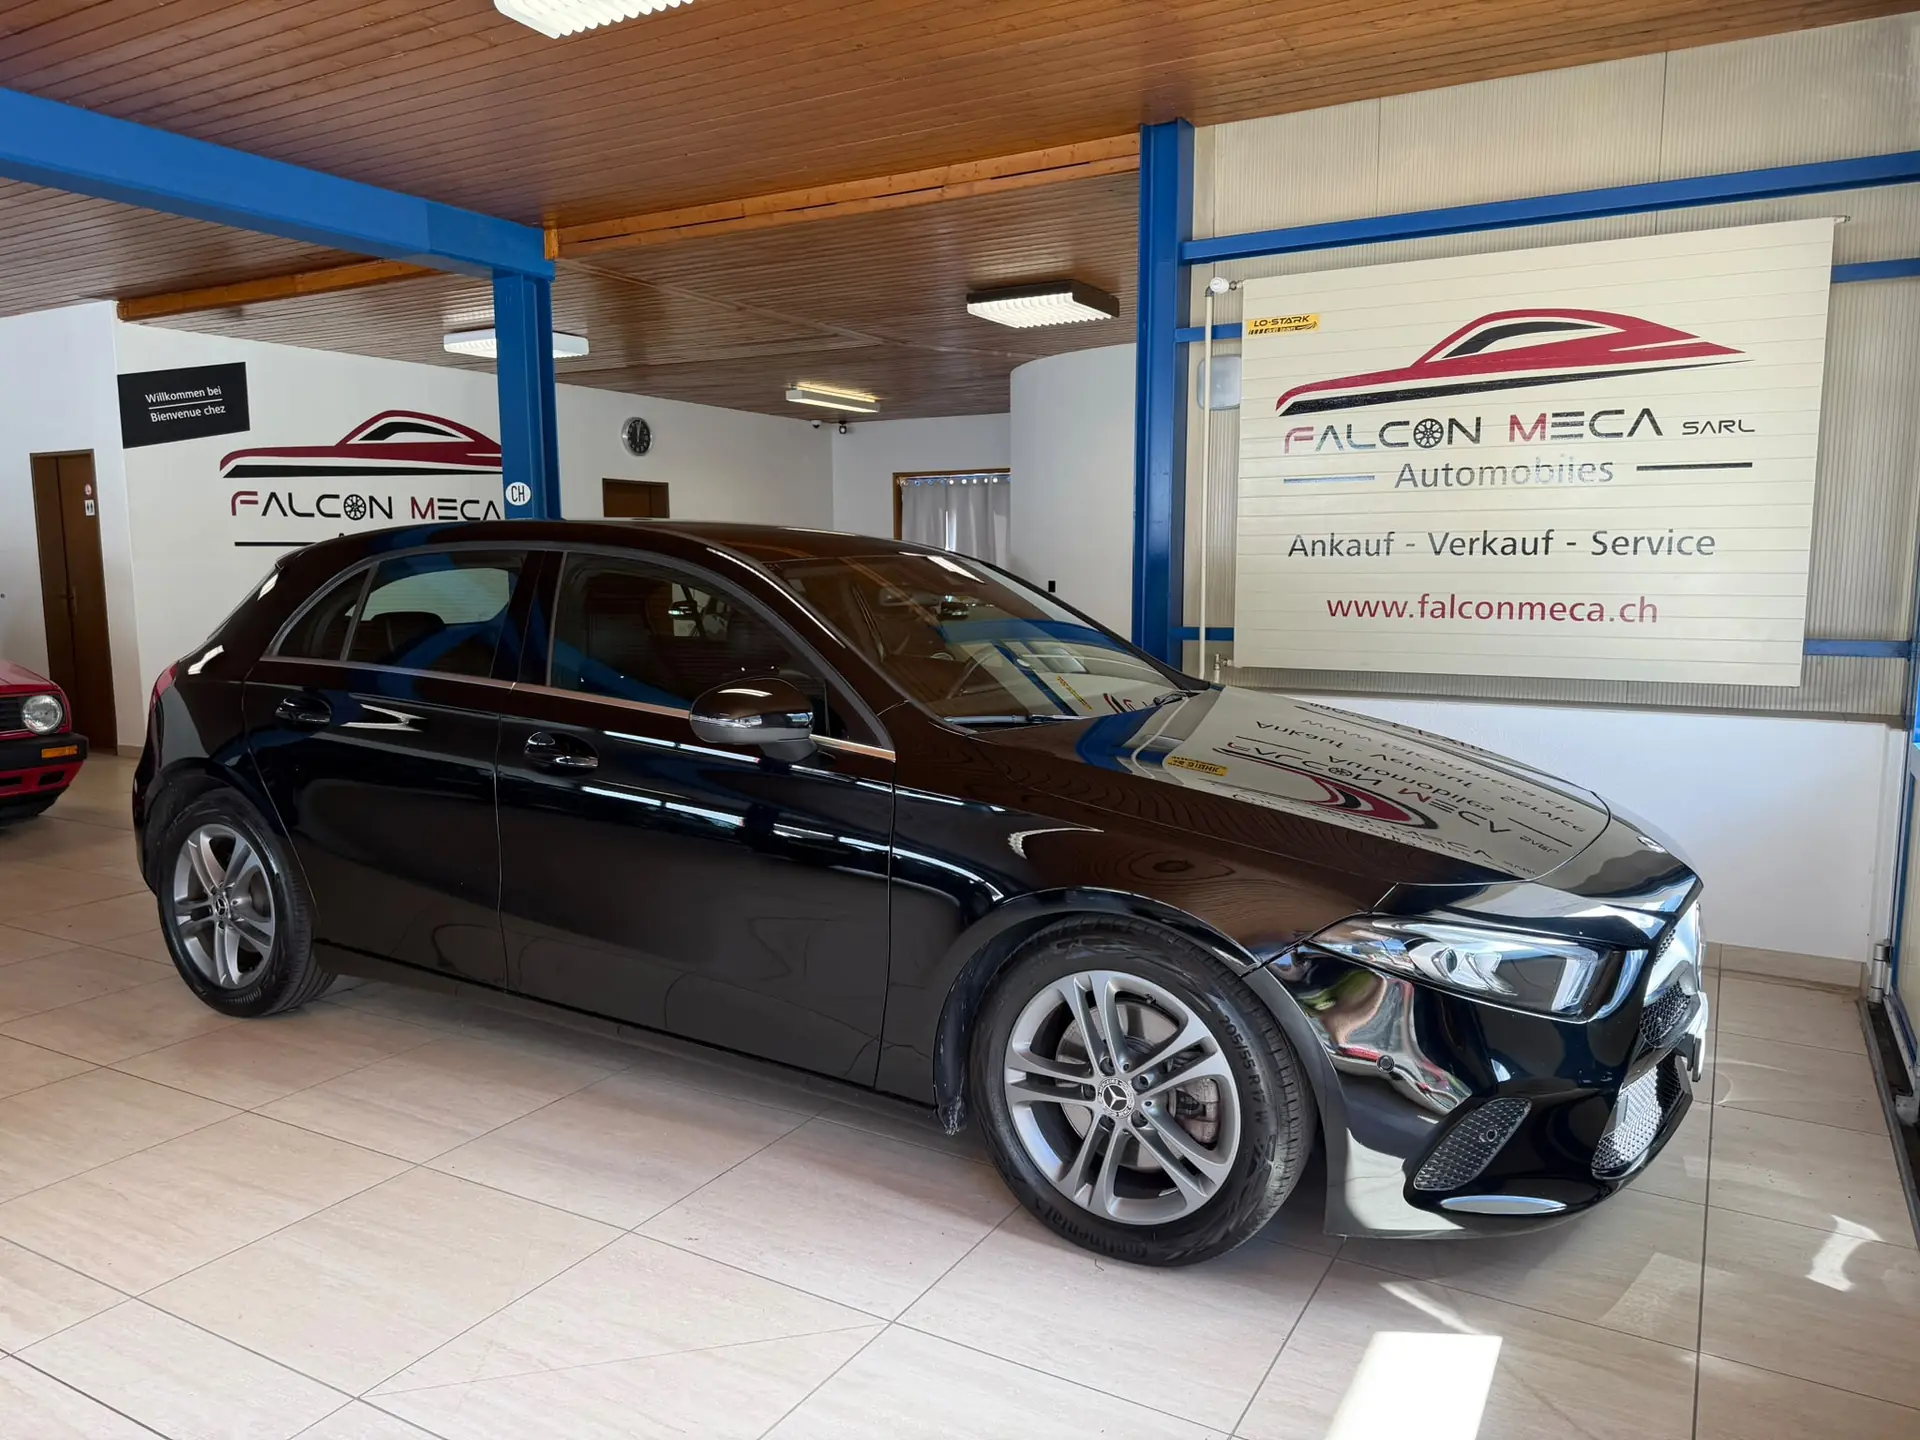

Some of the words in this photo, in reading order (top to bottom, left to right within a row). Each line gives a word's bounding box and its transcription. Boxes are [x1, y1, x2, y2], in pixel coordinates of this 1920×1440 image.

[145, 389, 206, 403] Willkommen
[206, 385, 222, 396] bei
[150, 409, 202, 422] Bienvenue
[203, 405, 226, 415] chez
[1284, 416, 1481, 455] FALCON
[1508, 407, 1664, 443] MECA
[1681, 418, 1756, 436] SARL
[1394, 453, 1614, 489] Automobiles
[231, 490, 393, 521] FALCON
[410, 496, 501, 520] MECA
[510, 486, 525, 503] CH
[1288, 532, 1396, 557] Ankauf
[1427, 529, 1555, 557] Verkauf
[1590, 529, 1716, 556] Service
[1326, 592, 1659, 624] www.falconmeca.ch
